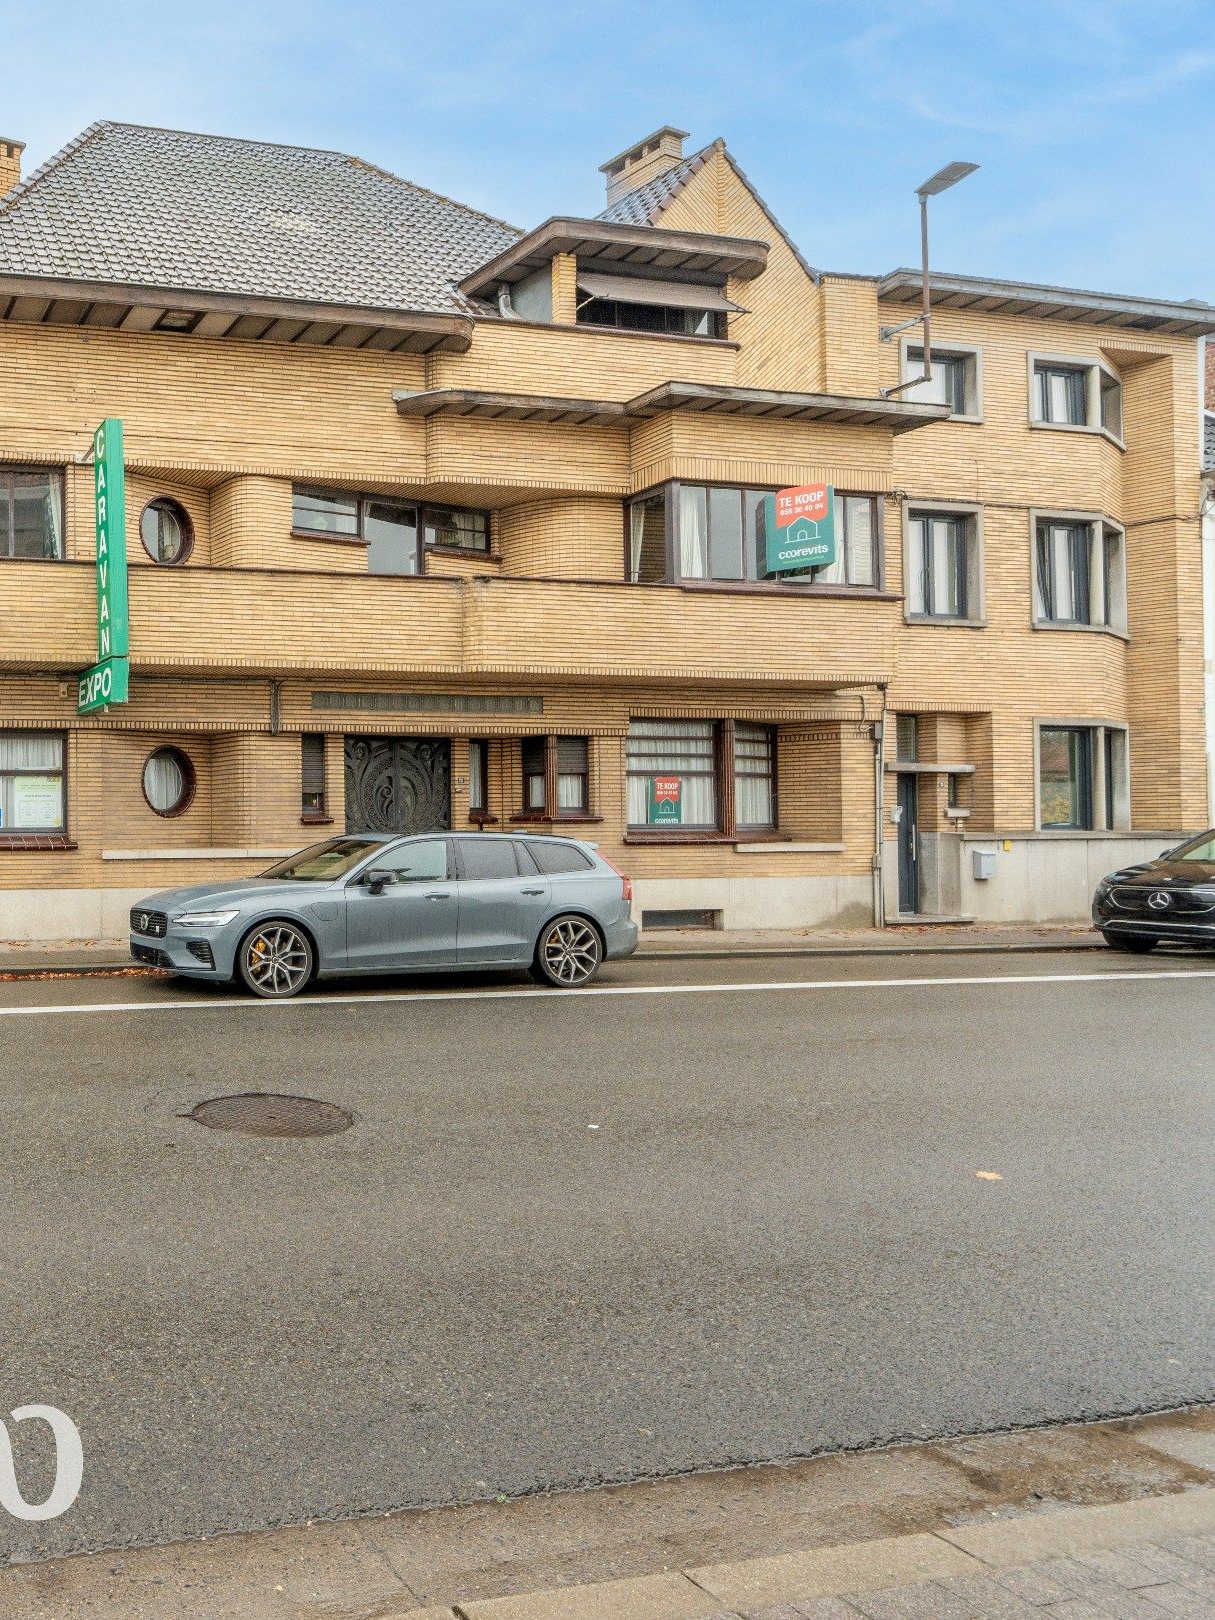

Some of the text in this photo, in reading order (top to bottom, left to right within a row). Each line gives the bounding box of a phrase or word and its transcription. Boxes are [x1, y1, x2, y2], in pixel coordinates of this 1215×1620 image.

[779, 491, 824, 508] TE KOOP
[780, 508, 793, 516] 055
[96, 429, 110, 656] CARAVAN
[778, 544, 829, 560] coorevits
[78, 667, 112, 707] EXPO
